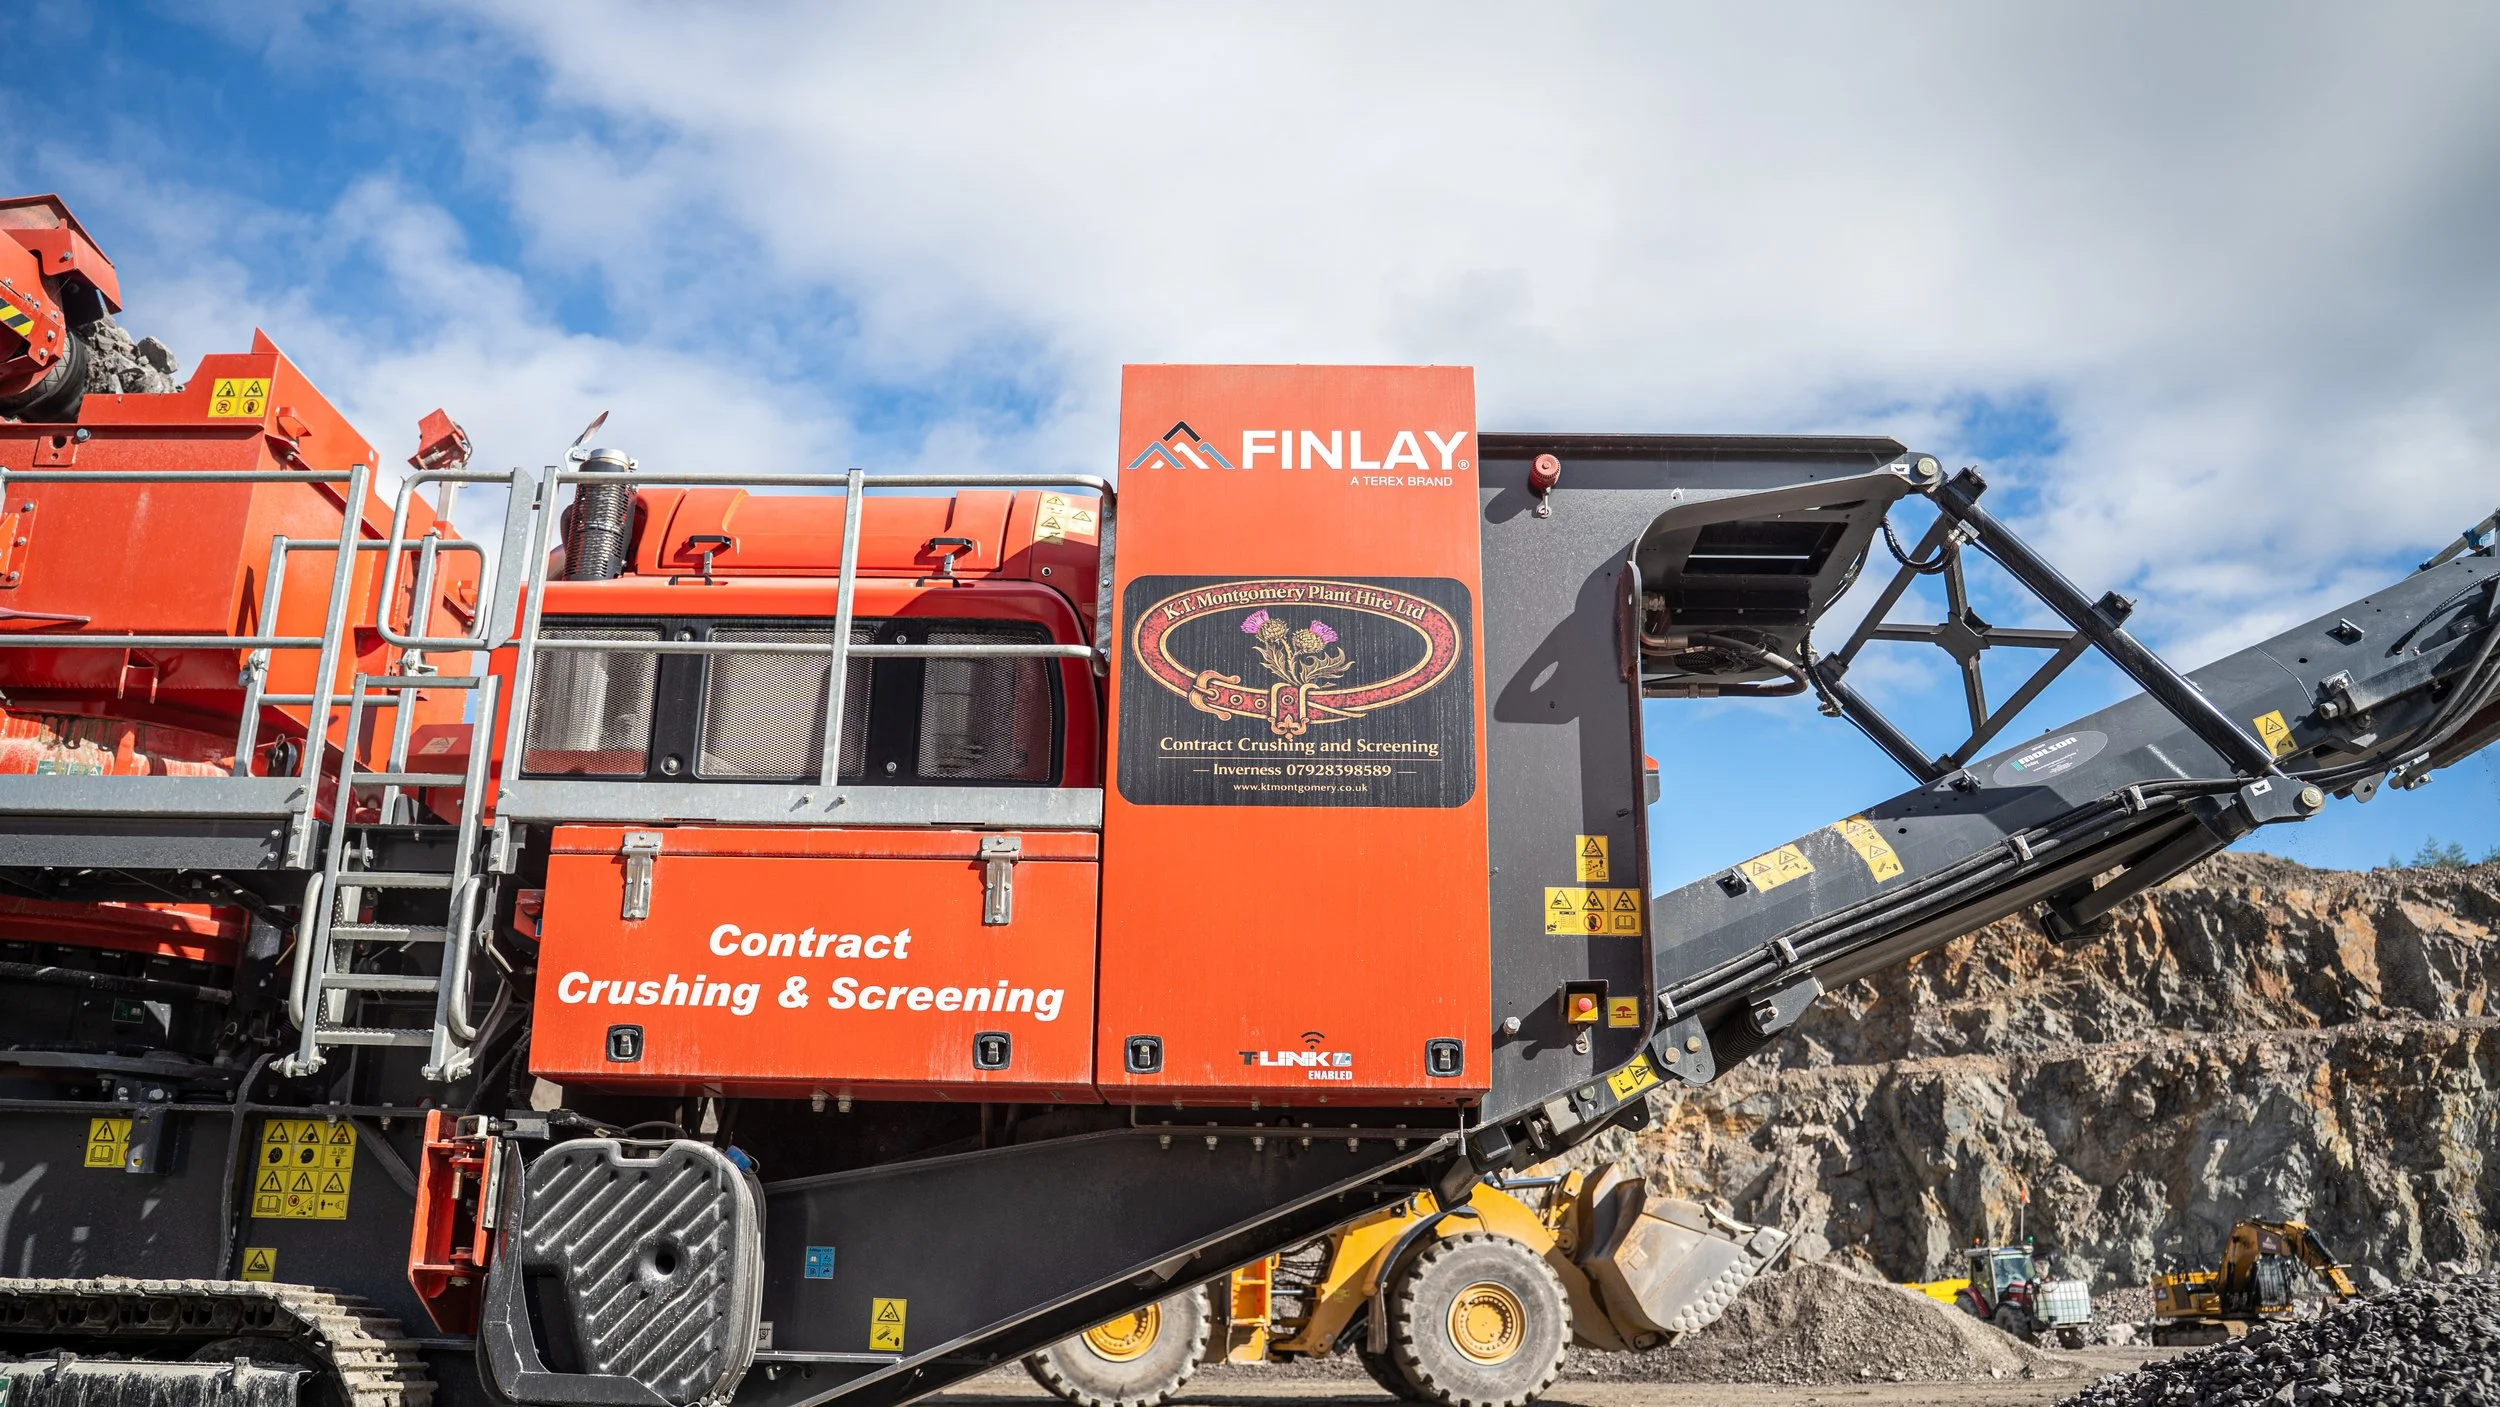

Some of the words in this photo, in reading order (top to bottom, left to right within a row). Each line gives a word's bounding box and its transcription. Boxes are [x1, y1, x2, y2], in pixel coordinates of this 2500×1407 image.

[1350, 476, 1360, 486] A
[1363, 476, 1404, 486] TEREX
[1407, 476, 1453, 487] BRAND
[1162, 597, 1196, 621] K.T.
[1196, 588, 1305, 608] Montgomery
[1308, 585, 1352, 603] Plant
[1355, 590, 1393, 611] Hire
[1395, 598, 1427, 620] Ltd
[1159, 736, 1233, 752] Contract
[1238, 737, 1315, 755] Crushing
[1320, 738, 1352, 752] and
[1356, 738, 1439, 756] Screening
[1213, 763, 1282, 776] Inverness
[1286, 763, 1392, 777] 07928398589
[1233, 781, 1368, 794] www.ktmontgomery.co.uk
[709, 923, 911, 960] Contract
[557, 971, 761, 1016] Crushing
[777, 975, 810, 1009] &
[827, 976, 1065, 1022] Screening
[1308, 1070, 1353, 1081] ENABLED
